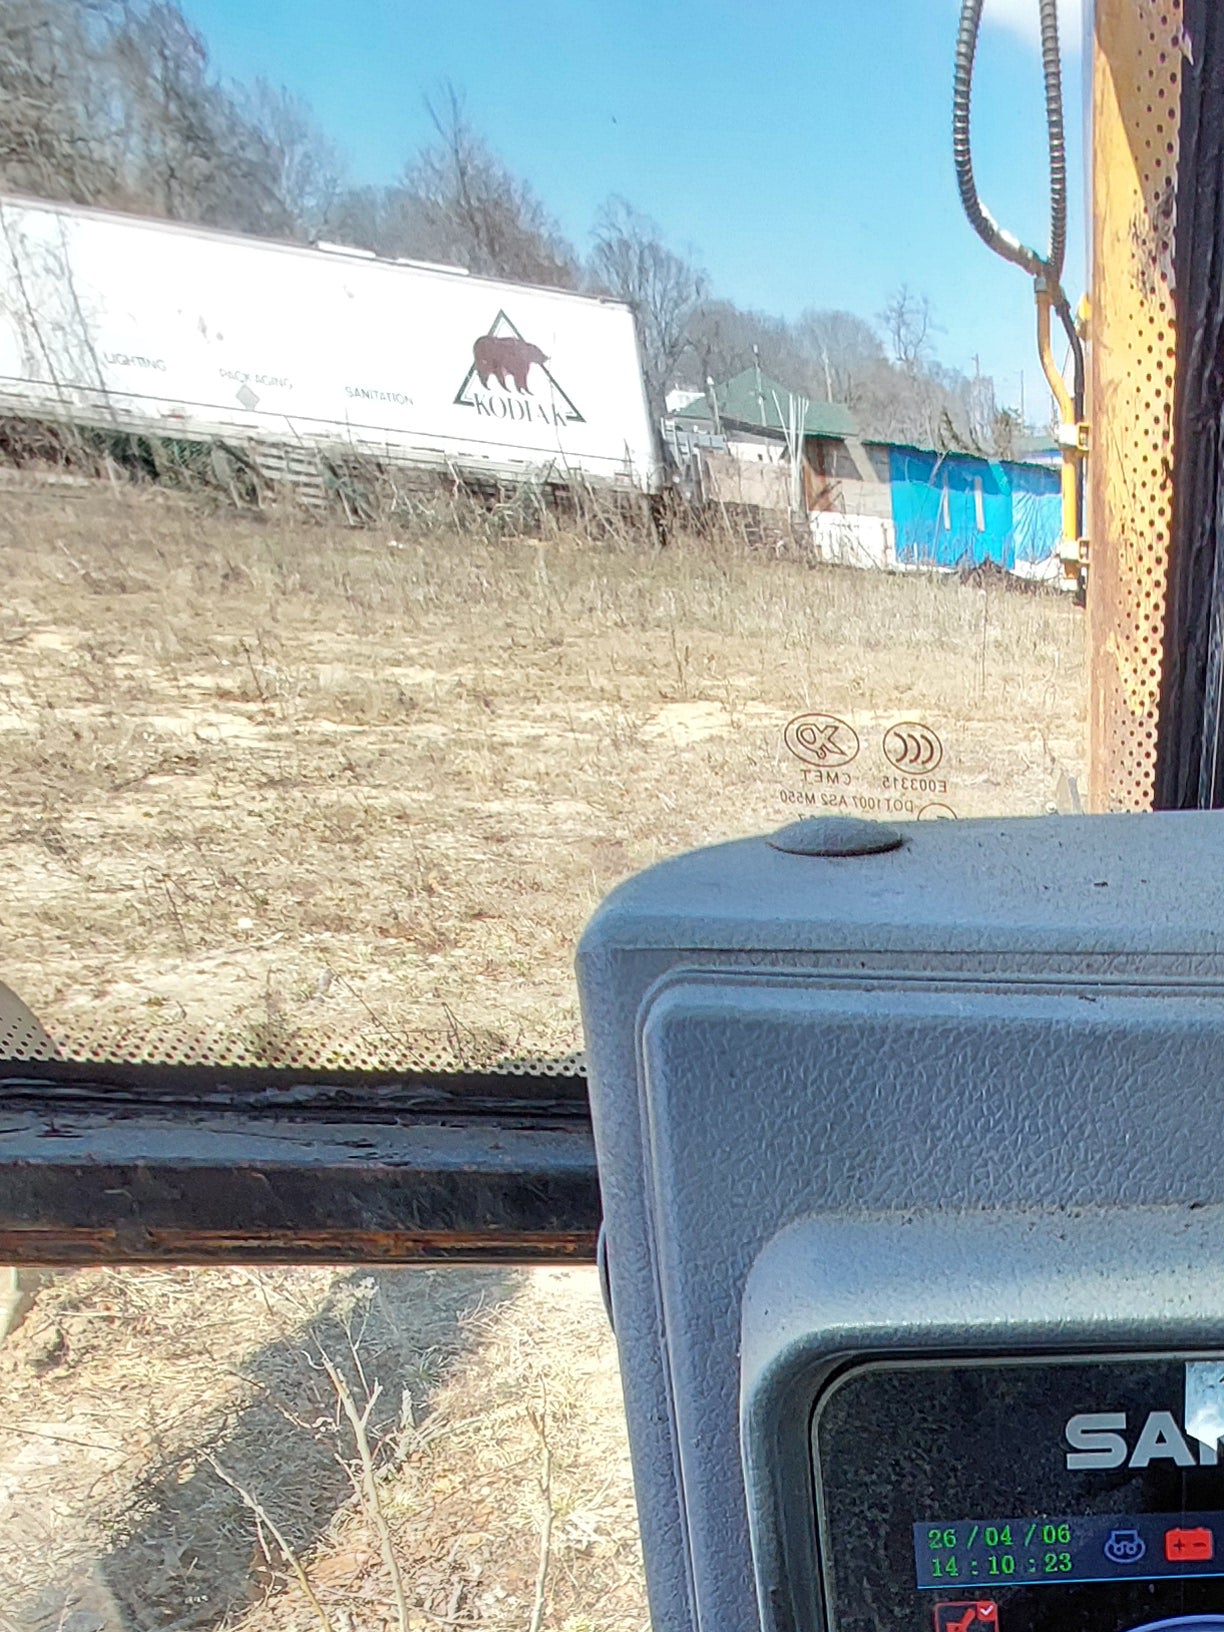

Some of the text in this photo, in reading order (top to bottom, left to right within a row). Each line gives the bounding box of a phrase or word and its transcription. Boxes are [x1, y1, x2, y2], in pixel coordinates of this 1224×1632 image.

[103, 351, 167, 372] LIGHTING
[345, 386, 414, 406] SANITATION
[474, 392, 568, 427] KODIAK
